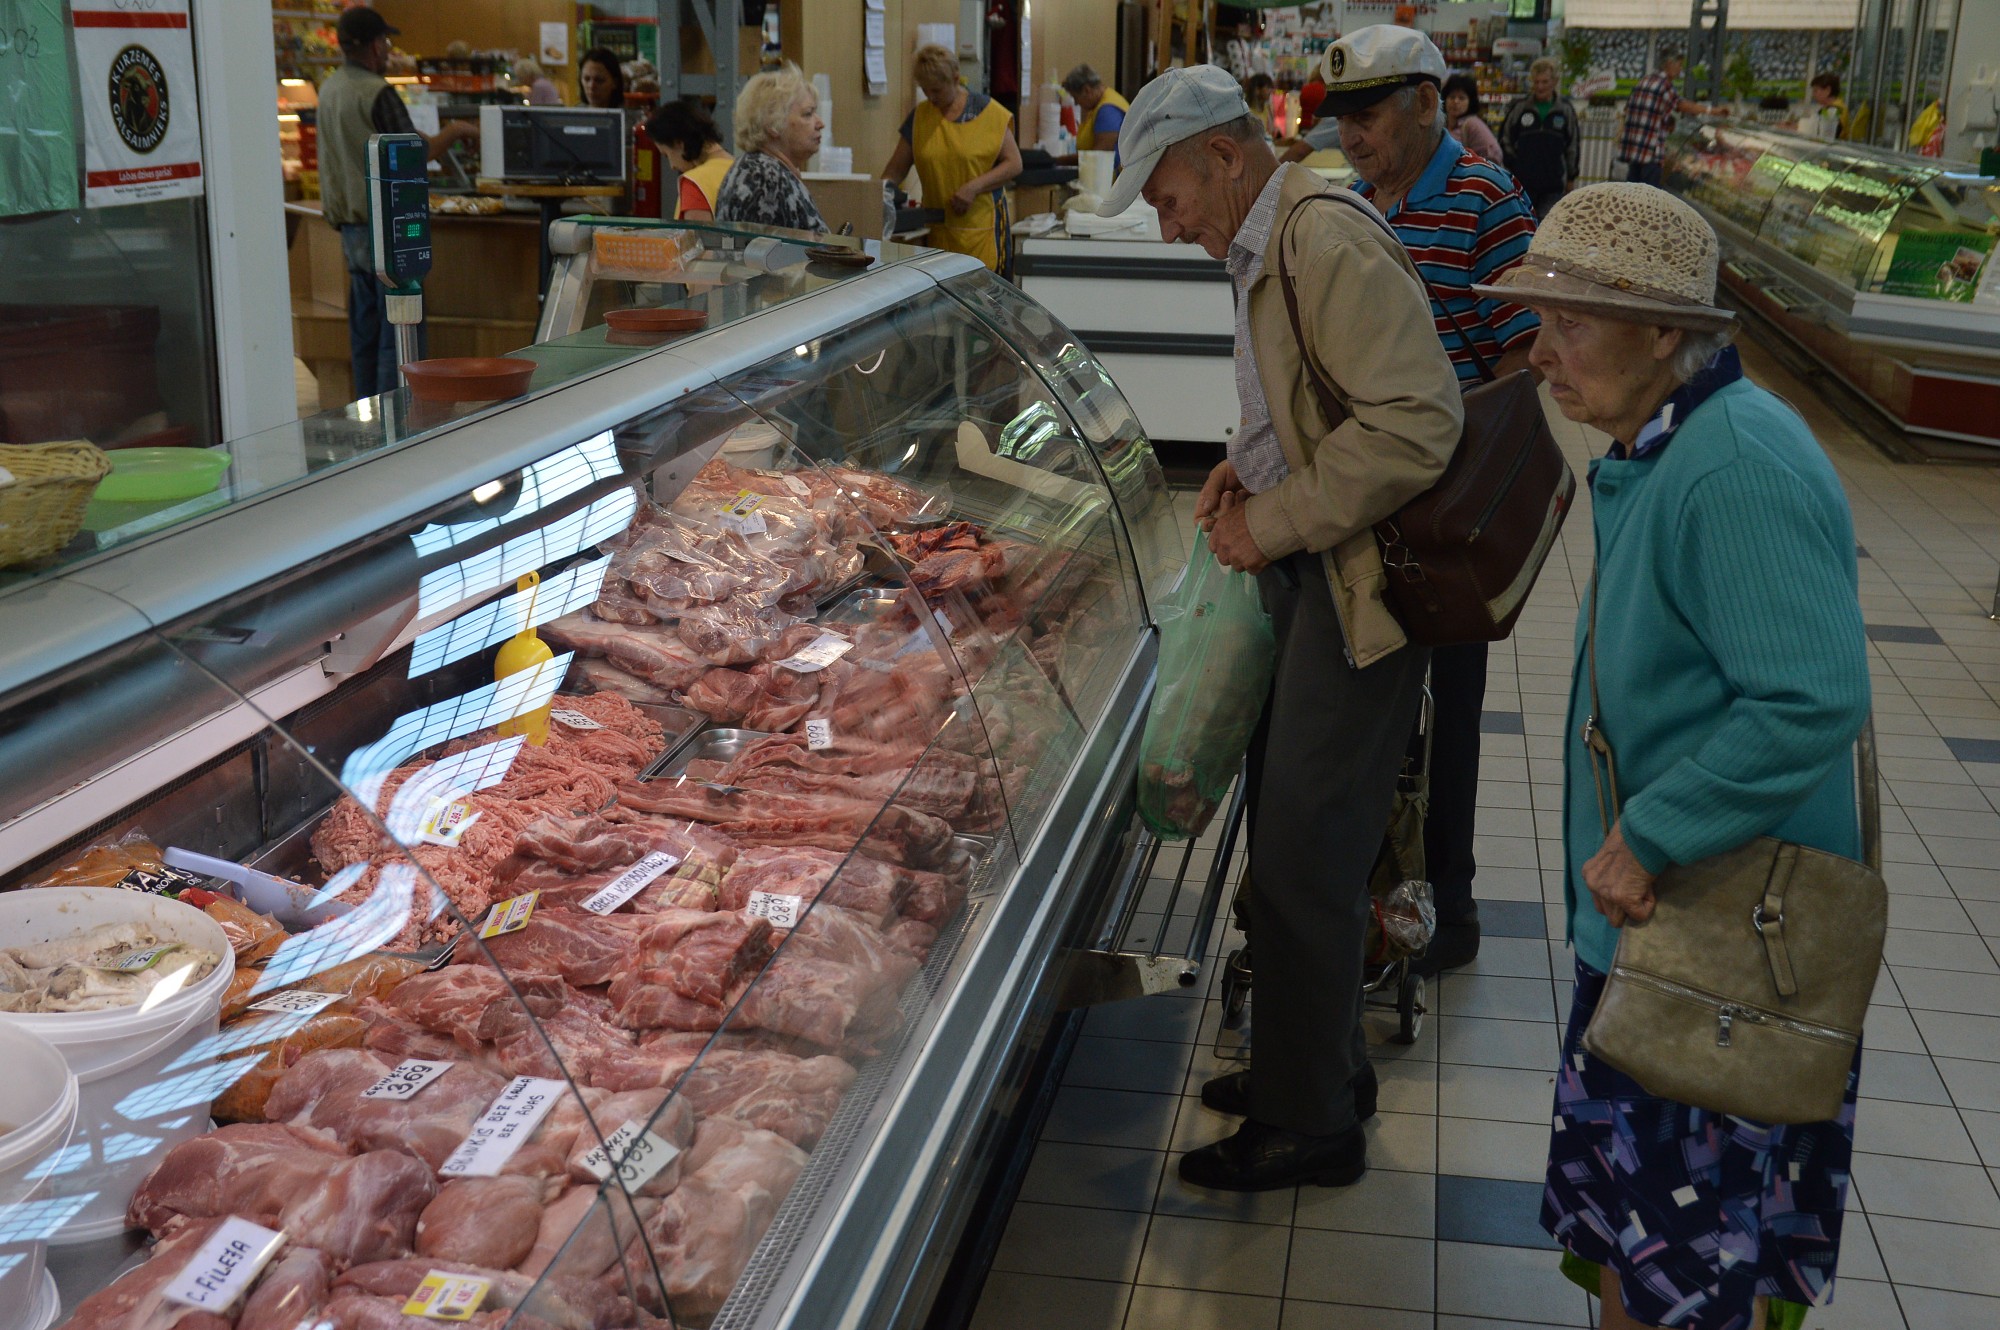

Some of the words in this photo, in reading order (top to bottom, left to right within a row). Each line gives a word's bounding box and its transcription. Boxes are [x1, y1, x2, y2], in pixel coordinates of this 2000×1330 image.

[112, 50, 161, 84] KURZEMES
[770, 898, 790, 922] 3.89
[387, 1064, 433, 1094] 3.69
[487, 1104, 511, 1122] BEZ
[497, 1122, 519, 1138] BEZ
[515, 1094, 544, 1116] ĀDAS
